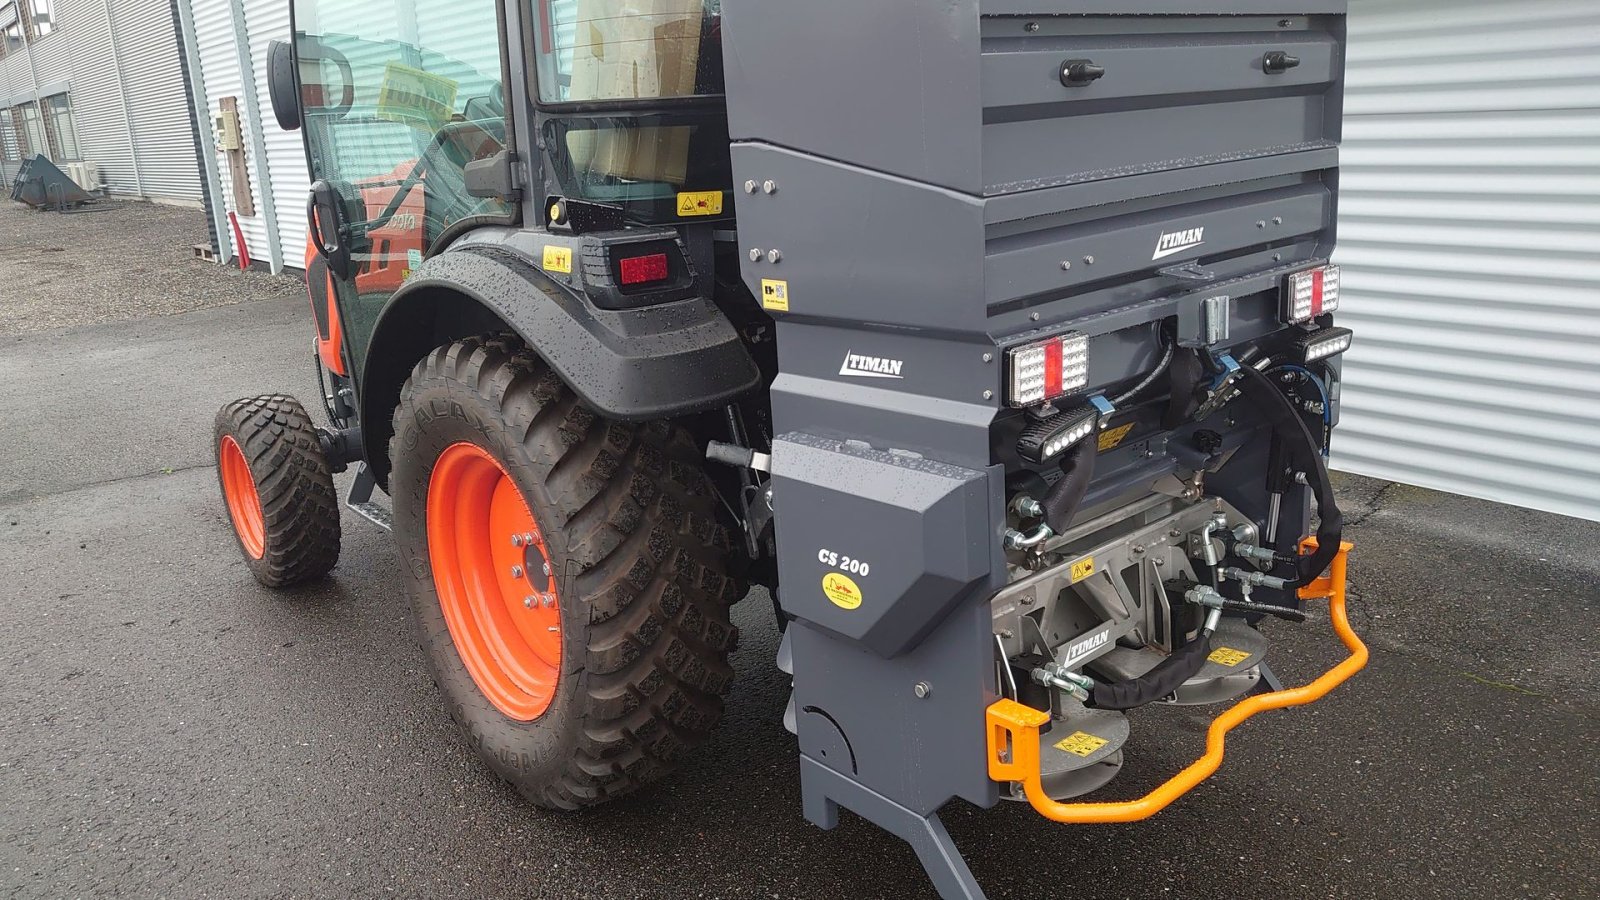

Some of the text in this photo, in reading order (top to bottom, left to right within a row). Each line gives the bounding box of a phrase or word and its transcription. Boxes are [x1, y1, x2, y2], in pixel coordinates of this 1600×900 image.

[1162, 226, 1204, 250] TIMAN
[849, 354, 903, 376] TIMAN
[818, 548, 870, 577] CS 200
[1070, 629, 1110, 659] TIMAN
